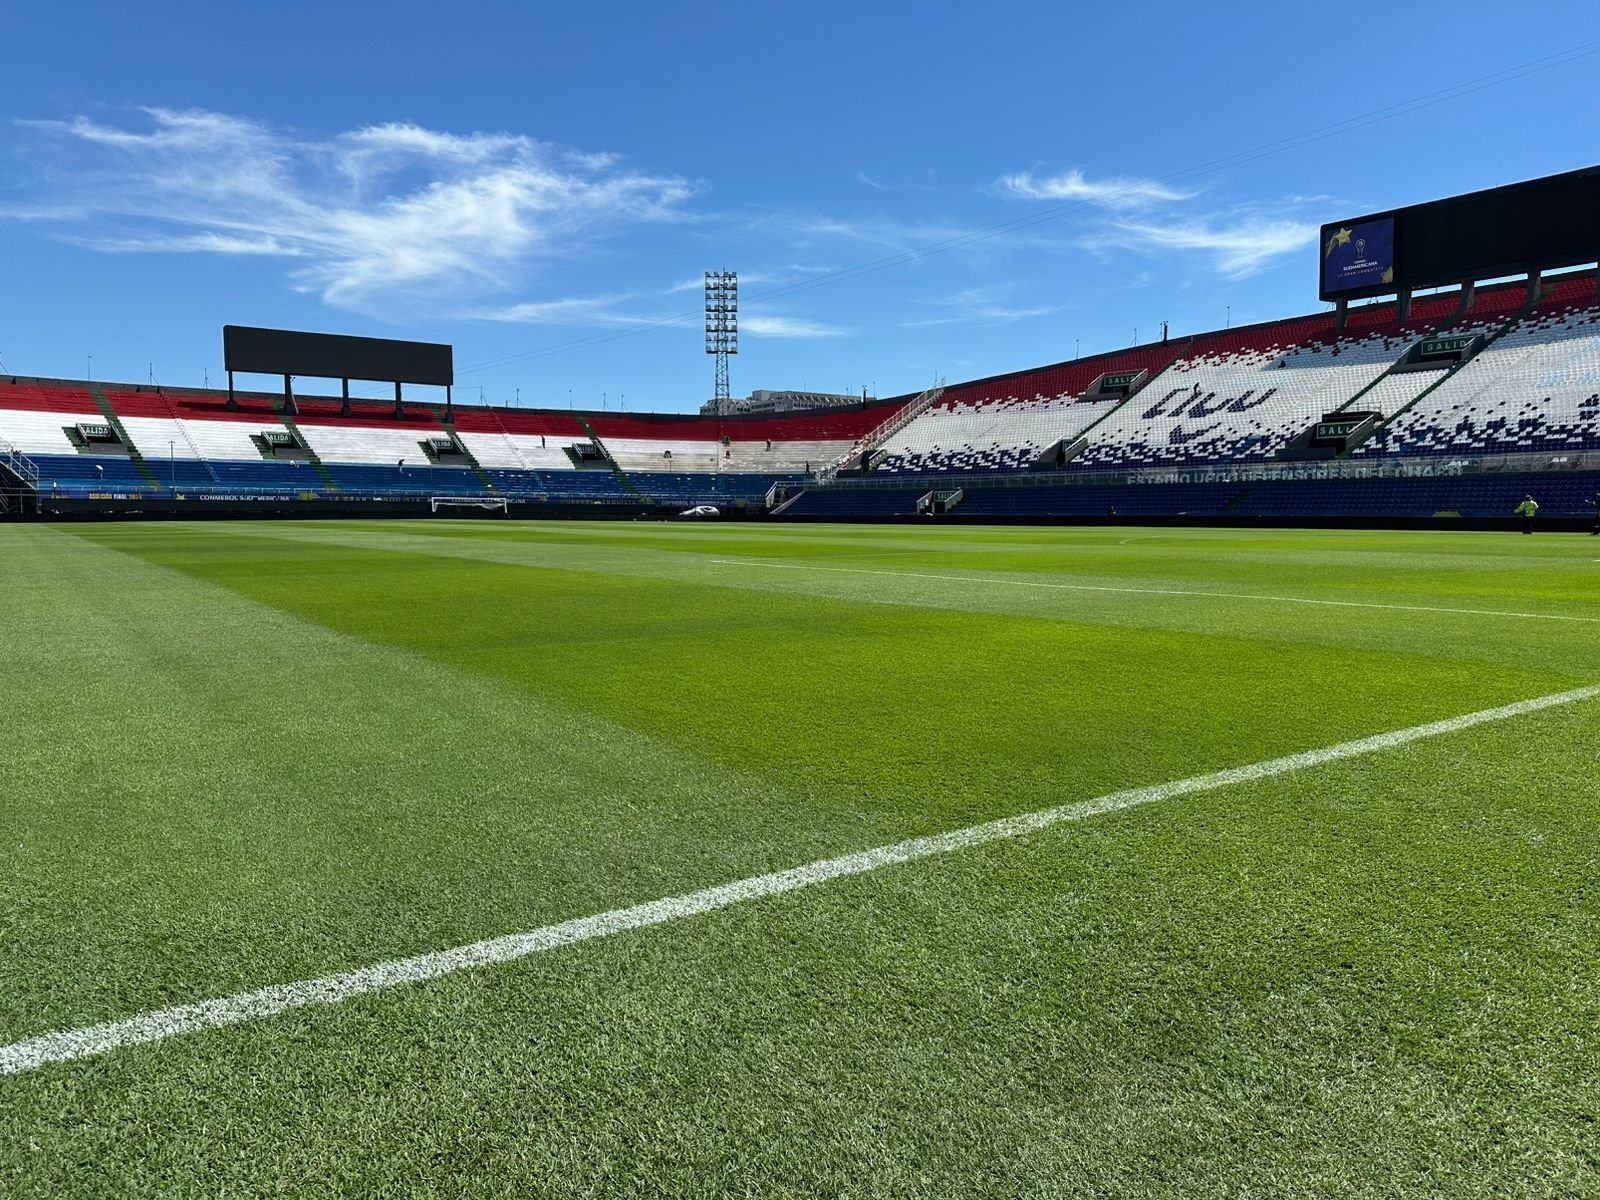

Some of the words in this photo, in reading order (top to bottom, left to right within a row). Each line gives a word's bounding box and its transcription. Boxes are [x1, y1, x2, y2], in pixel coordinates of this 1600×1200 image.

[1343, 260, 1378, 271] SUDAMERICANA
[1427, 340, 1467, 351] SALID
[84, 426, 108, 434] ALIDA
[1320, 426, 1350, 435] SALI
